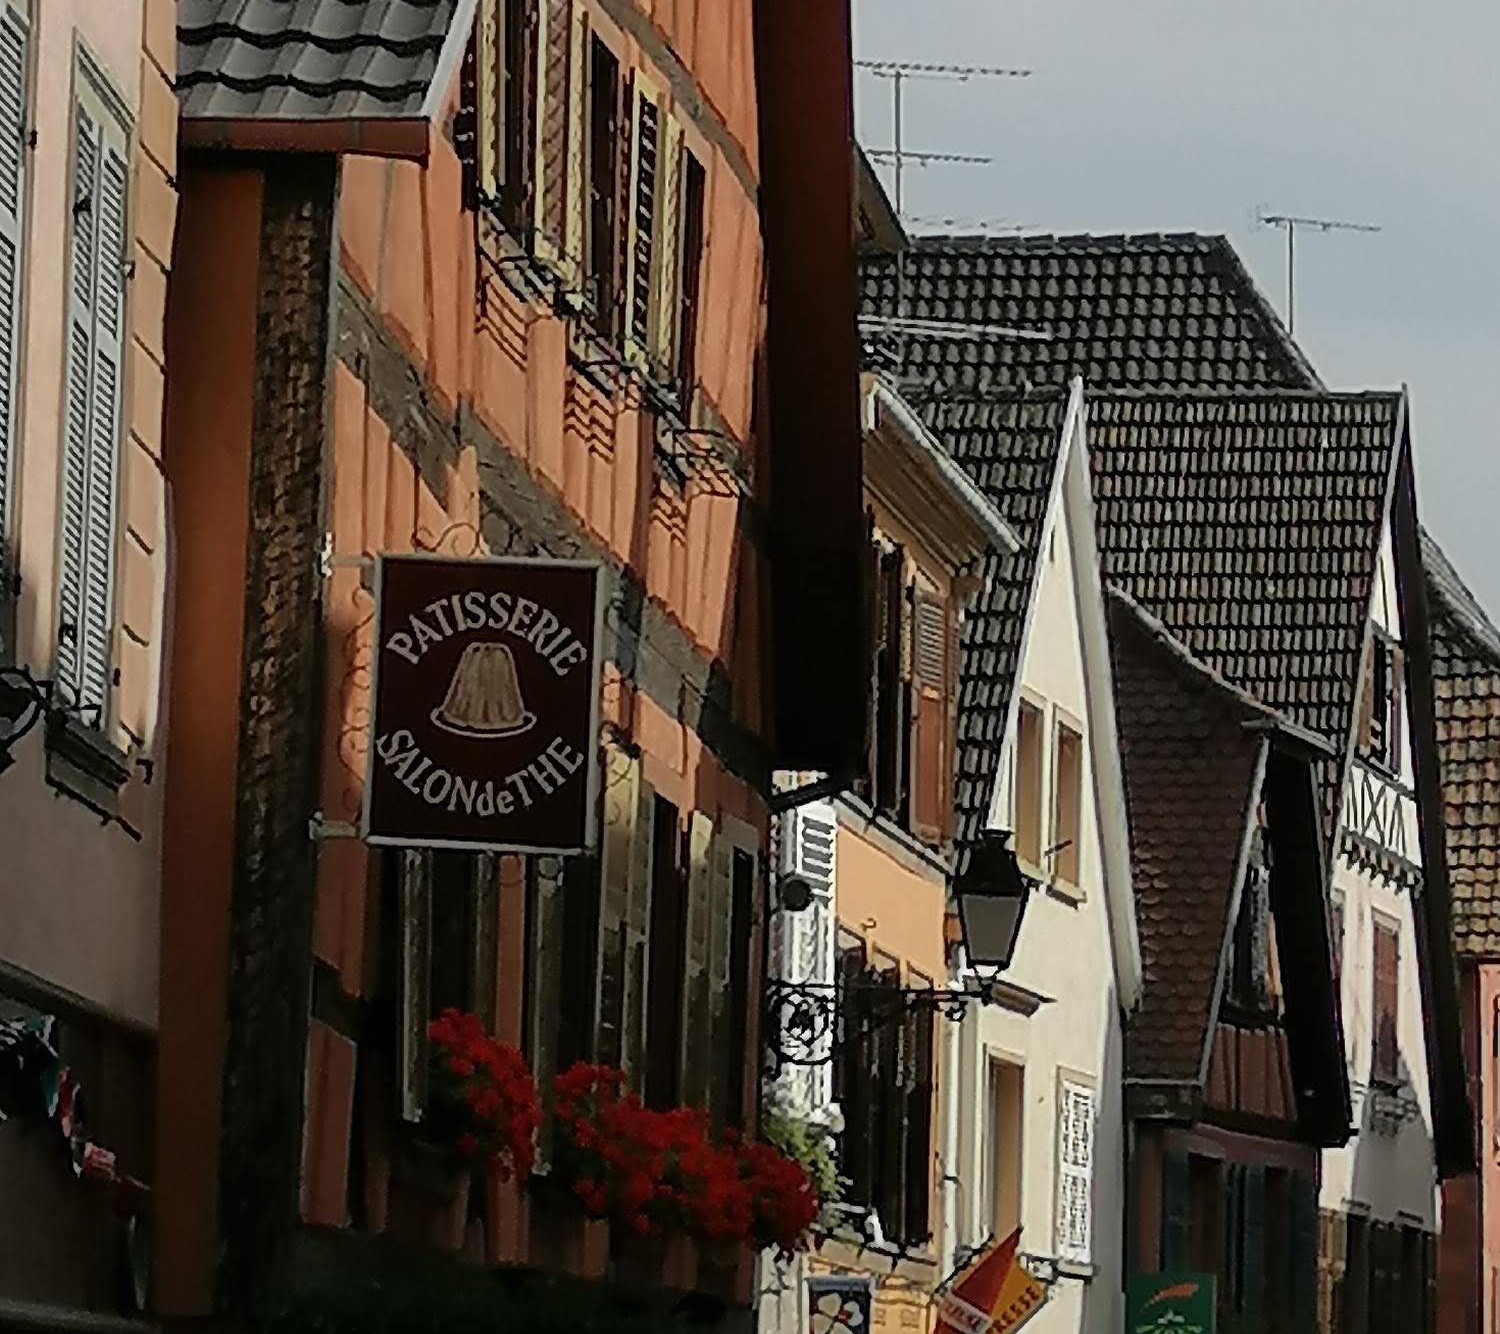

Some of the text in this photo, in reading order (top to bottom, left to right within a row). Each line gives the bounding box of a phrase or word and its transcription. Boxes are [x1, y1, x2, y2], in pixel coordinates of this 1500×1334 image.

[386, 590, 588, 677] PATISSERIE
[376, 729, 584, 816] SALON de THE
